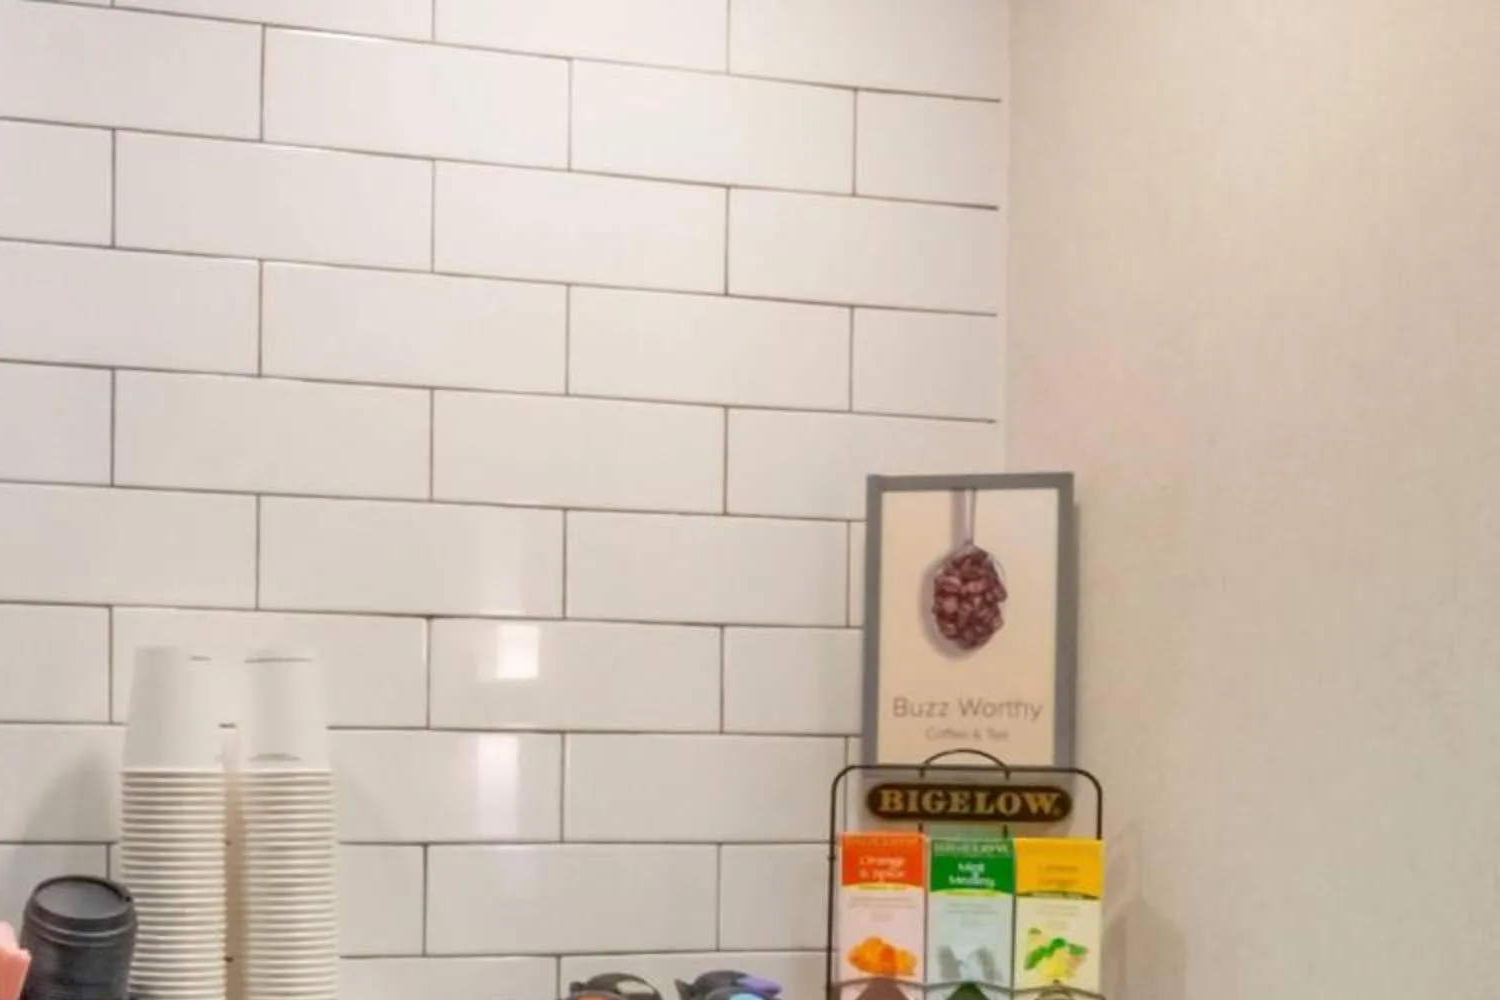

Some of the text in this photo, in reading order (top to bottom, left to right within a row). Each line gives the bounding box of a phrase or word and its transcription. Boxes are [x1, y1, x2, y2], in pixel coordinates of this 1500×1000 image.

[892, 696, 1044, 723] Buzz Worthy
[879, 788, 1061, 816] BIGELOW
